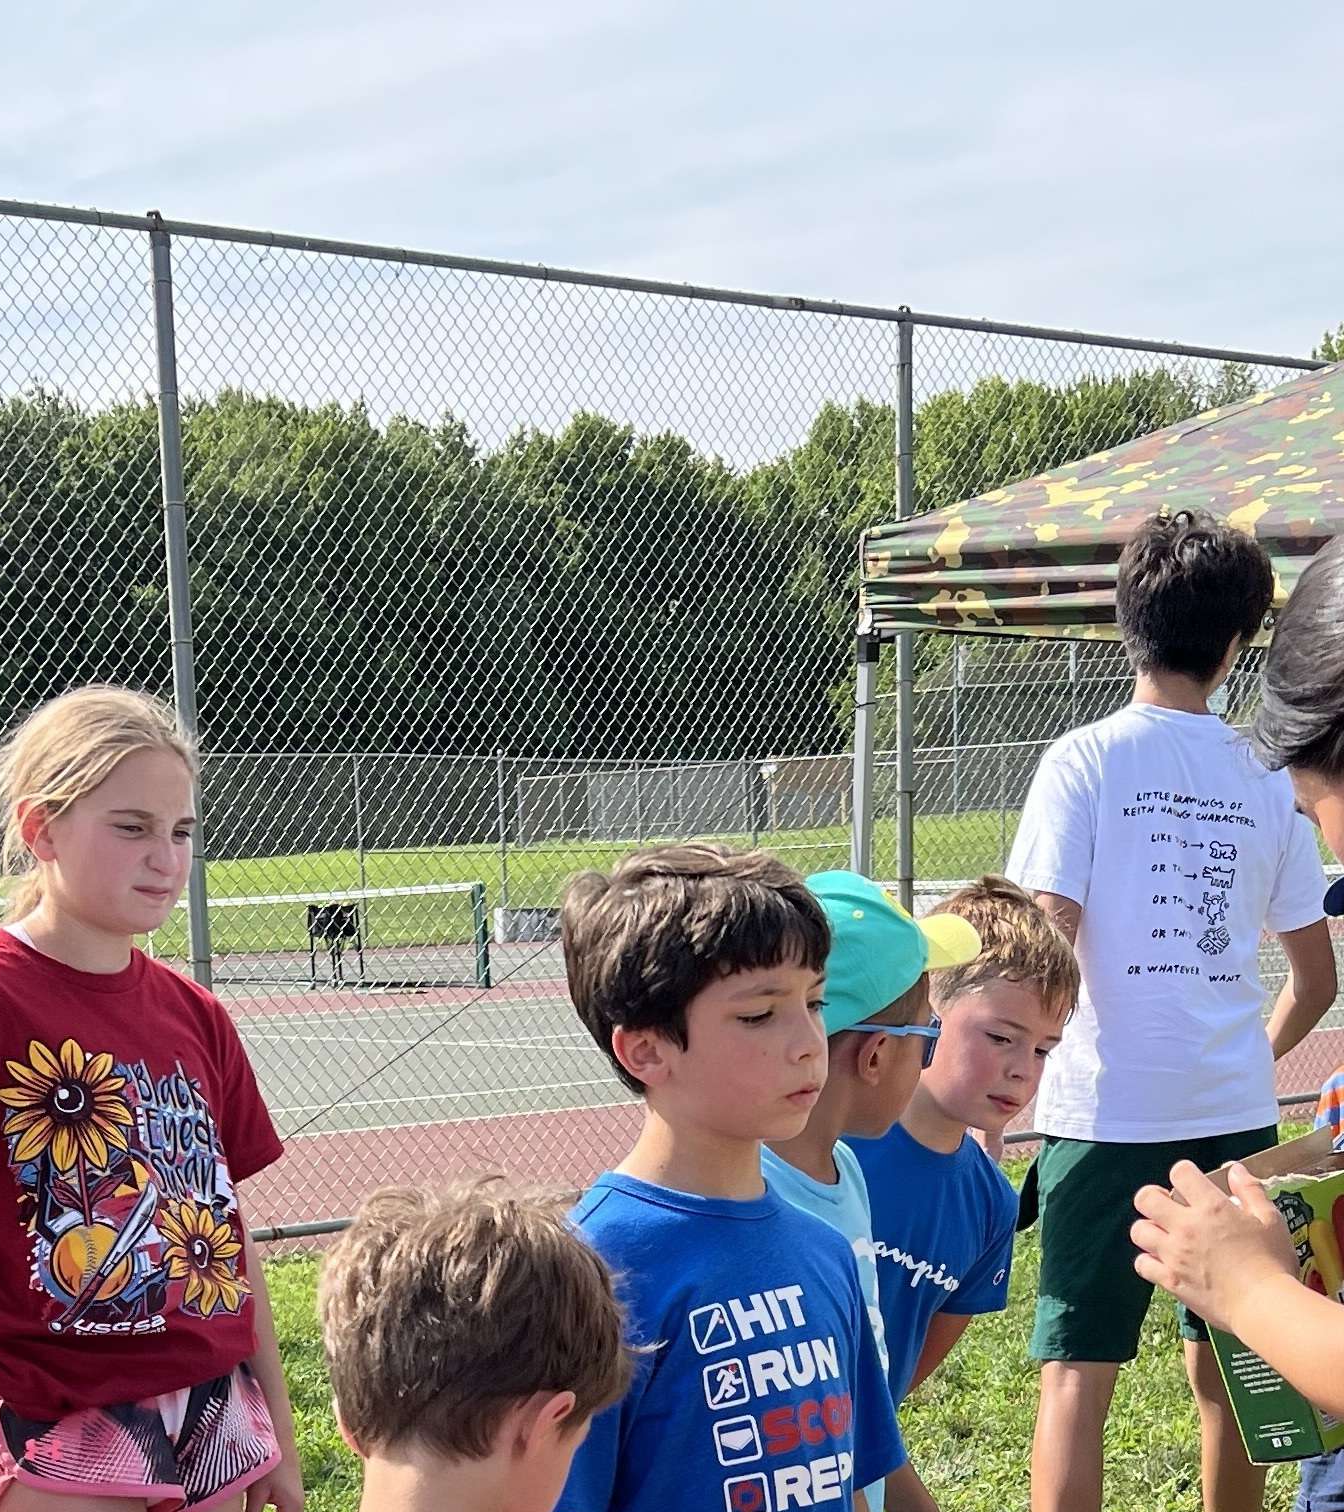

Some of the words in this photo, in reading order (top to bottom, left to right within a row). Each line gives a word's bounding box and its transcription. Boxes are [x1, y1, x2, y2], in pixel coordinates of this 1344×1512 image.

[1135, 791, 1171, 802] LITTLE
[1229, 801, 1244, 811] OF
[1122, 805, 1155, 817] KEITH
[1160, 804, 1191, 820] HANG
[1150, 833, 1172, 843] LIKE
[1151, 863, 1166, 873] OR
[1152, 894, 1168, 905] OR
[1151, 928, 1167, 939] OR
[1127, 965, 1142, 975] OR
[1147, 963, 1200, 976] WHATEVER
[1208, 974, 1242, 983] WANT
[131, 1059, 203, 1110] Black
[144, 1104, 214, 1166] Eyed
[150, 1152, 217, 1200] Susan
[727, 1284, 807, 1341] HIT
[746, 1336, 841, 1398] RUN
[773, 1450, 853, 1512] REP
